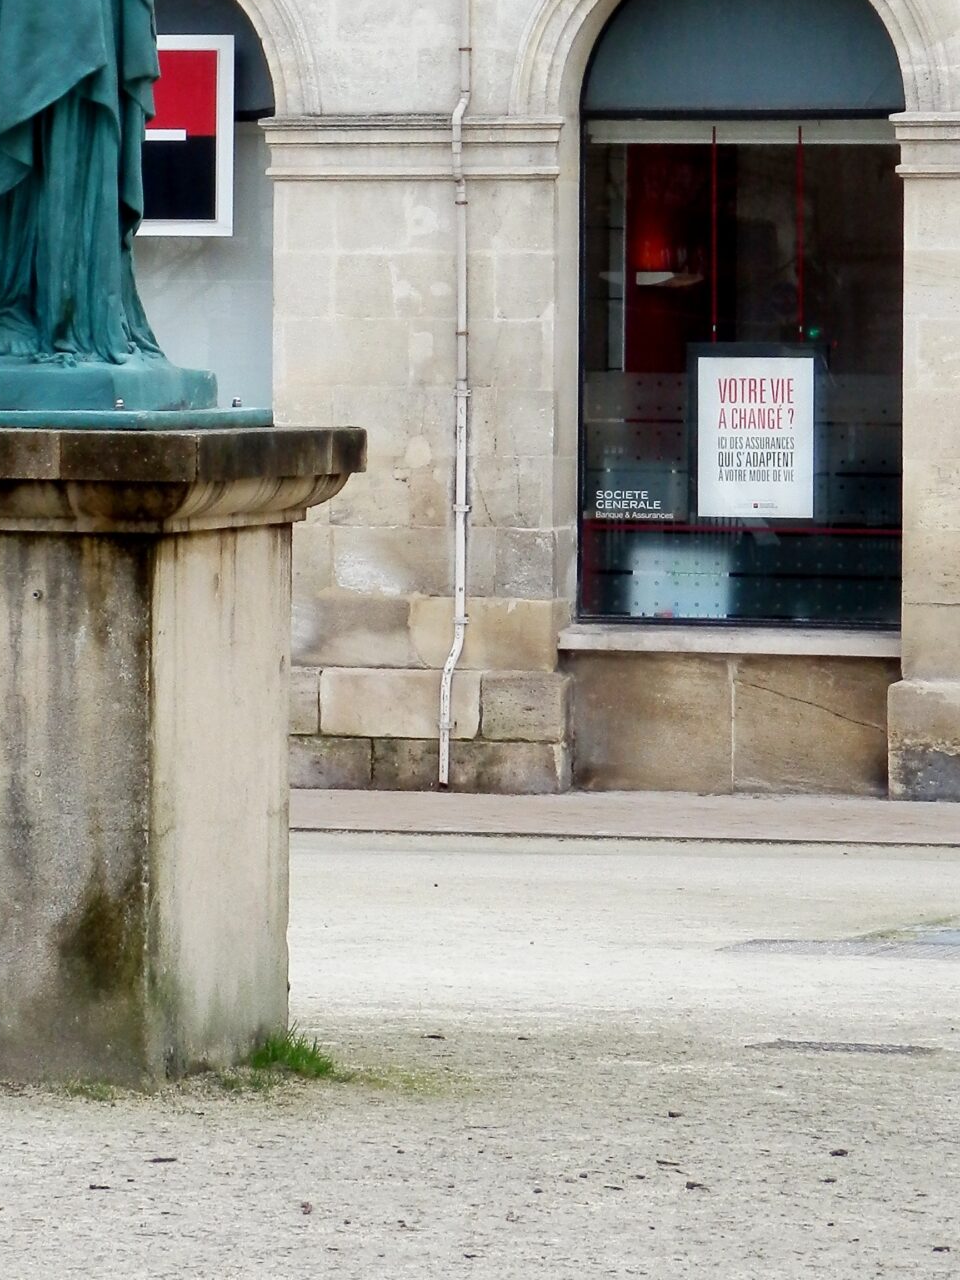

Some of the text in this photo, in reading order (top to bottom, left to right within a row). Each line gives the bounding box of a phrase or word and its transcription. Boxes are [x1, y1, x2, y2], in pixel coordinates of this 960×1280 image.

[718, 378, 794, 404] VOTRE VIE
[718, 404, 794, 429] A CHANGÉ ?
[717, 436, 795, 449] ICI DES ASSURANCES
[718, 451, 794, 467] QUI S'ADAPTENT
[725, 469, 747, 482] VOTRE
[749, 469, 770, 482] MODE
[772, 469, 781, 482] DE
[783, 469, 794, 482] VIE
[595, 490, 649, 500] SOCIETE
[595, 500, 662, 510] GENERALE
[595, 510, 674, 519] Banque & Assurances
